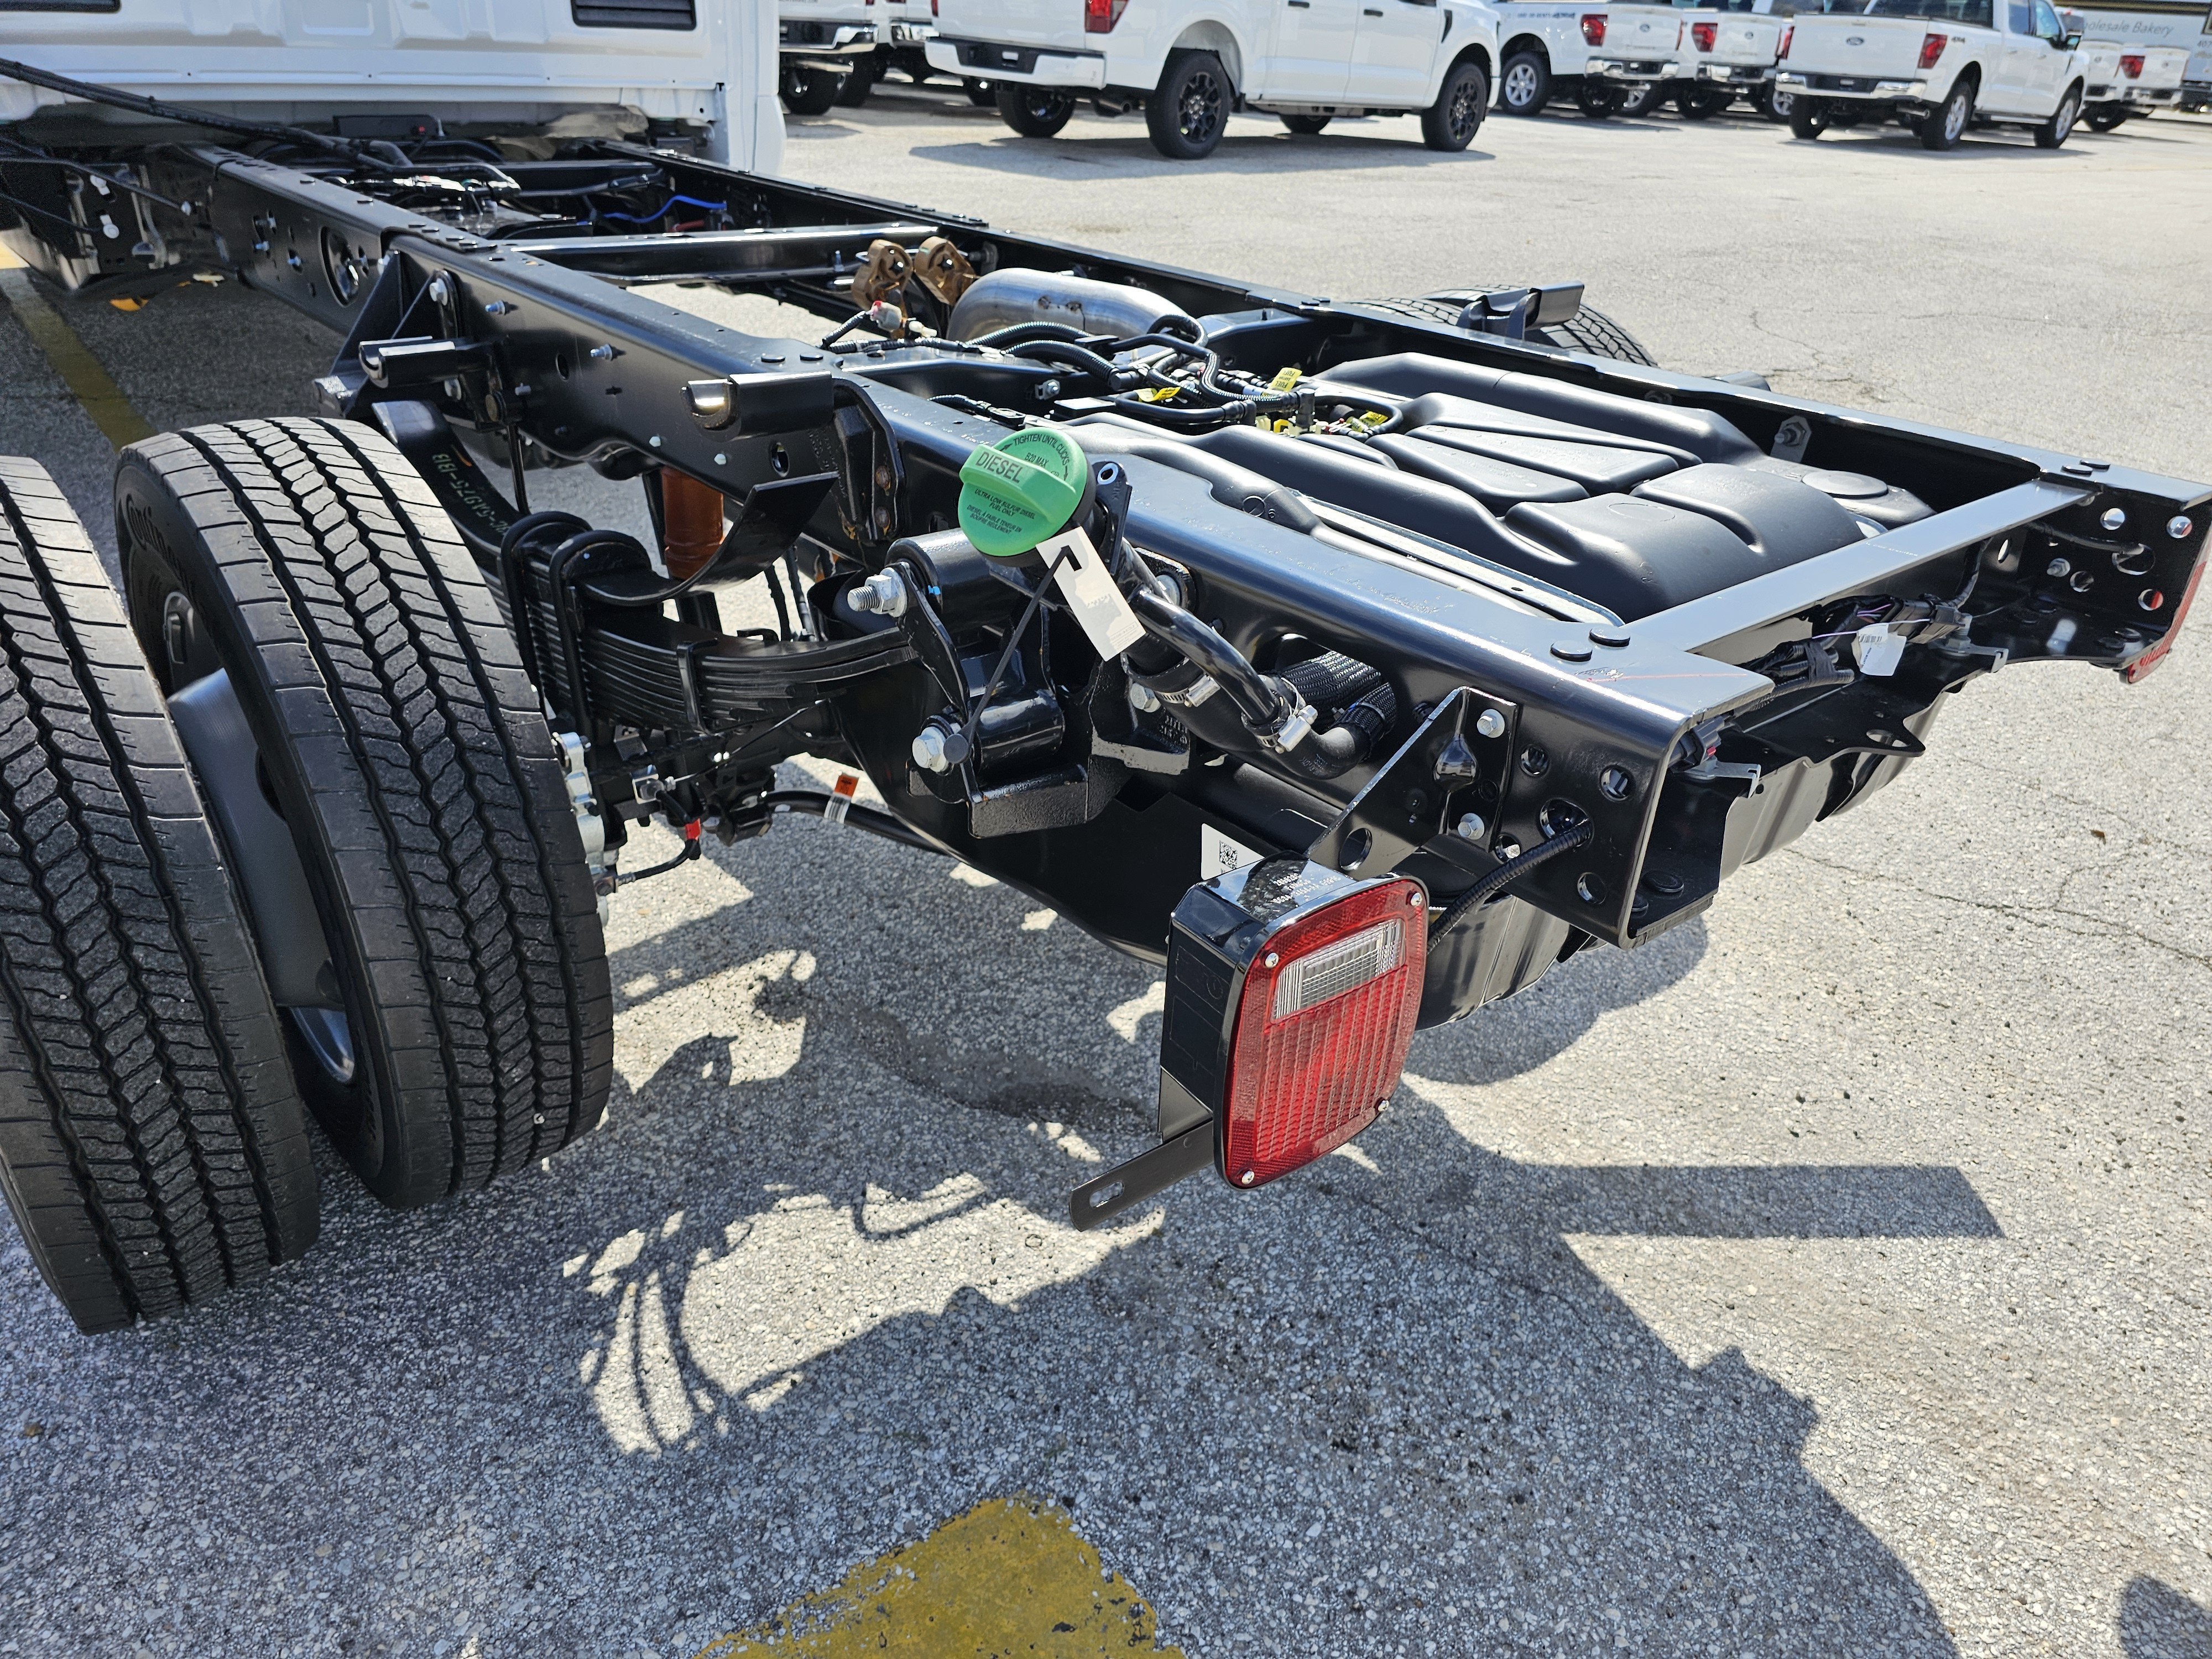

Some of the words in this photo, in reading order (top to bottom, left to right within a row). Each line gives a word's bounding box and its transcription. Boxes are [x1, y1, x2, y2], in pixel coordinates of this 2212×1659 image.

[2085, 20, 2130, 33] olesale
[2132, 20, 2174, 38] Bakery
[1014, 434, 1042, 446] TIGHTEN
[1042, 434, 1058, 448] UNTIL
[1056, 444, 1070, 466] CLICKS
[1025, 452, 1036, 463] B20
[1035, 456, 1049, 468] MAX
[975, 451, 1023, 483] DIESEL
[974, 488, 990, 500] ULTRA
[990, 495, 1002, 504] LOW
[1001, 501, 1021, 513] SULFUR
[1020, 509, 1035, 519] DIESEL
[989, 502, 1001, 512] FUEL
